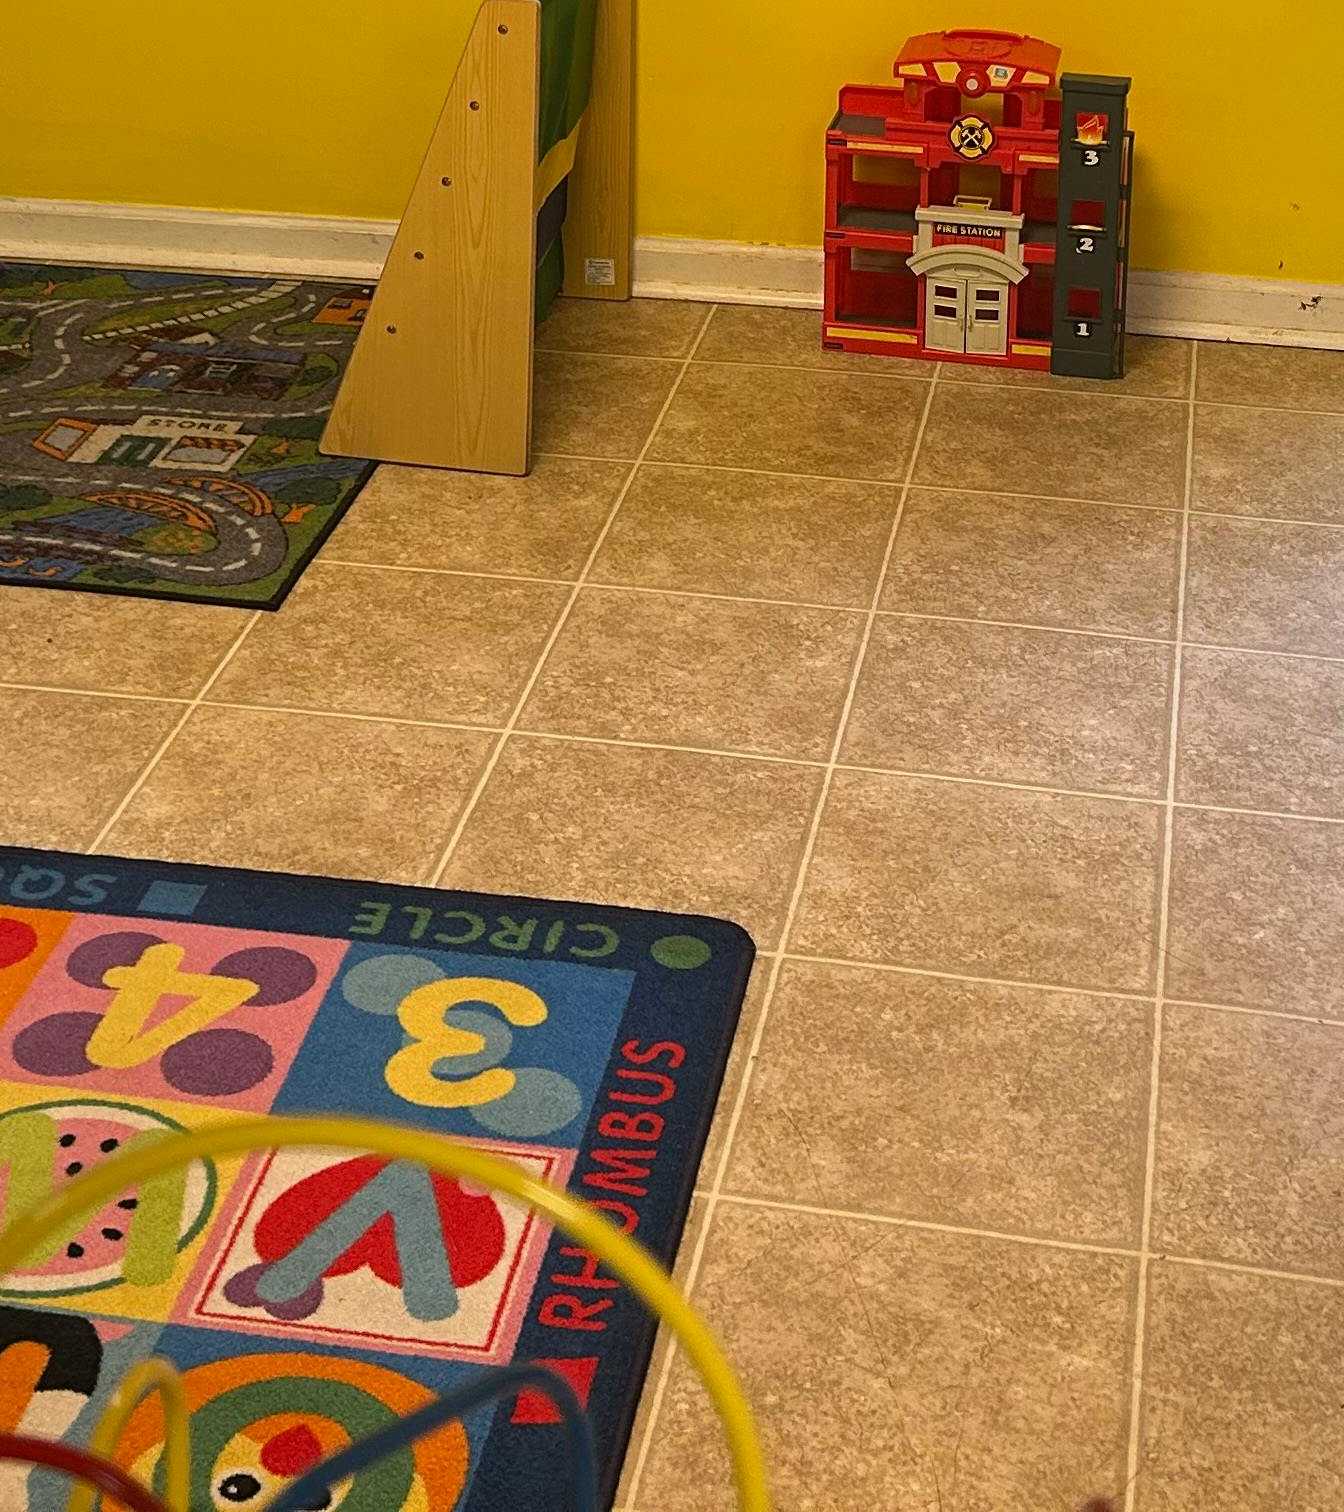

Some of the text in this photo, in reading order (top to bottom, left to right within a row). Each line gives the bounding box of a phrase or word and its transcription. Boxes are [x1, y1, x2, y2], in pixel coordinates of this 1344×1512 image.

[1084, 149, 1100, 166] 3
[937, 224, 1000, 237] FIRE STATION
[1077, 237, 1094, 252] 2
[1076, 323, 1090, 338] 1
[147, 418, 228, 432] STORE
[348, 900, 621, 959] CIRCLE
[85, 942, 261, 1069] 4
[383, 976, 552, 1109] 3
